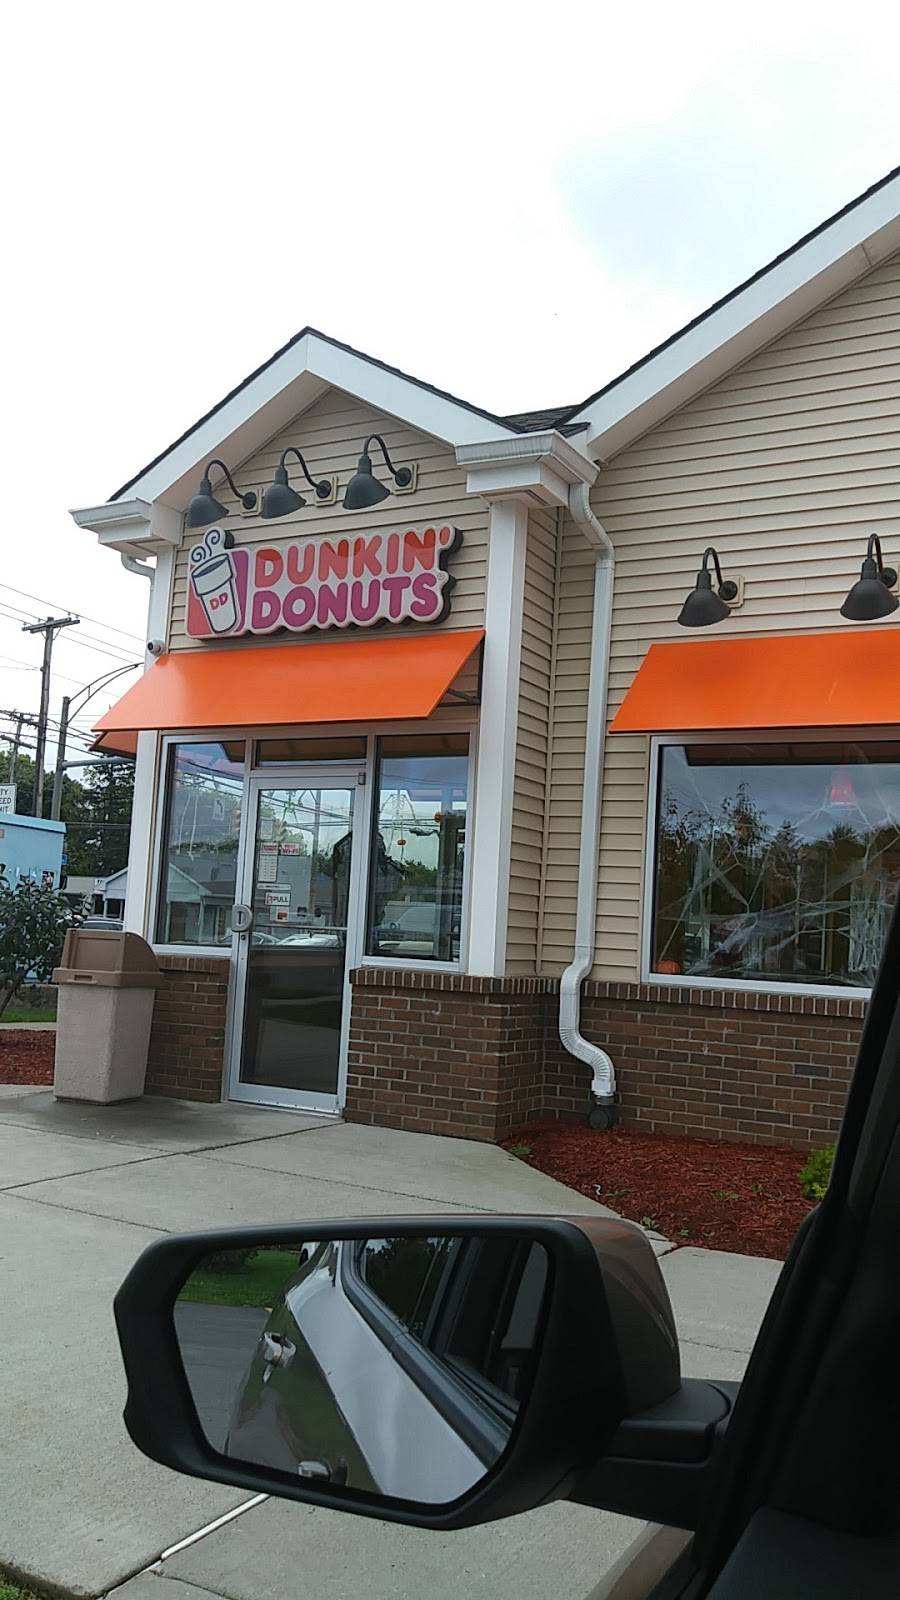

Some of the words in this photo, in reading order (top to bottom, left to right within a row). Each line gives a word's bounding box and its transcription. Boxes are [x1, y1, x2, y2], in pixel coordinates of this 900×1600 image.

[255, 526, 450, 588] DUNKIN'
[209, 591, 228, 610] DD
[252, 573, 438, 629] DONUTS
